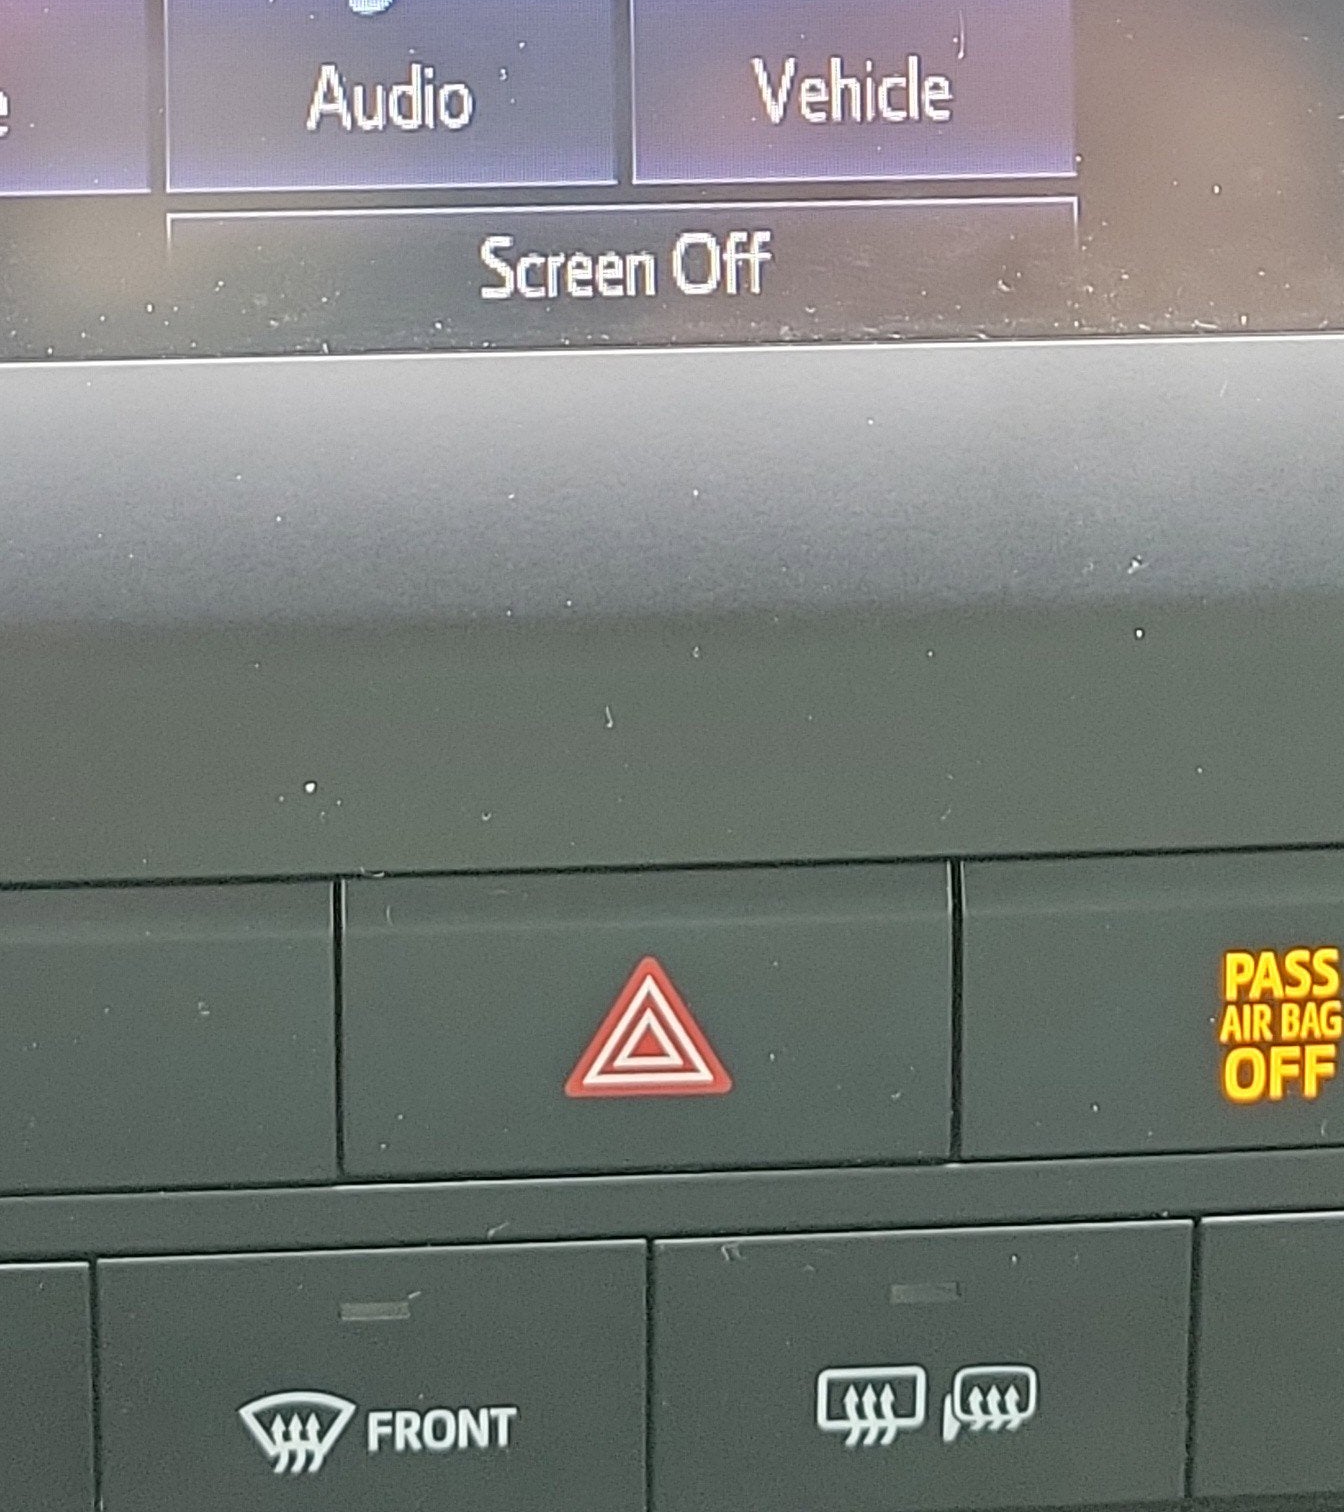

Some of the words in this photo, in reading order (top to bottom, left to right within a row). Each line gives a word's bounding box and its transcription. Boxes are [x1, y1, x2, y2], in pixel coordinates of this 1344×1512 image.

[306, 63, 474, 132] Audio
[753, 54, 953, 123] Vehicle
[480, 235, 655, 301] Screen
[671, 231, 772, 296] Off
[1224, 946, 1342, 1000] PASS
[1219, 1004, 1273, 1041] AIR
[1280, 1002, 1344, 1041] BAG
[1223, 1042, 1337, 1101] OFF
[366, 1405, 517, 1453] FRONT
